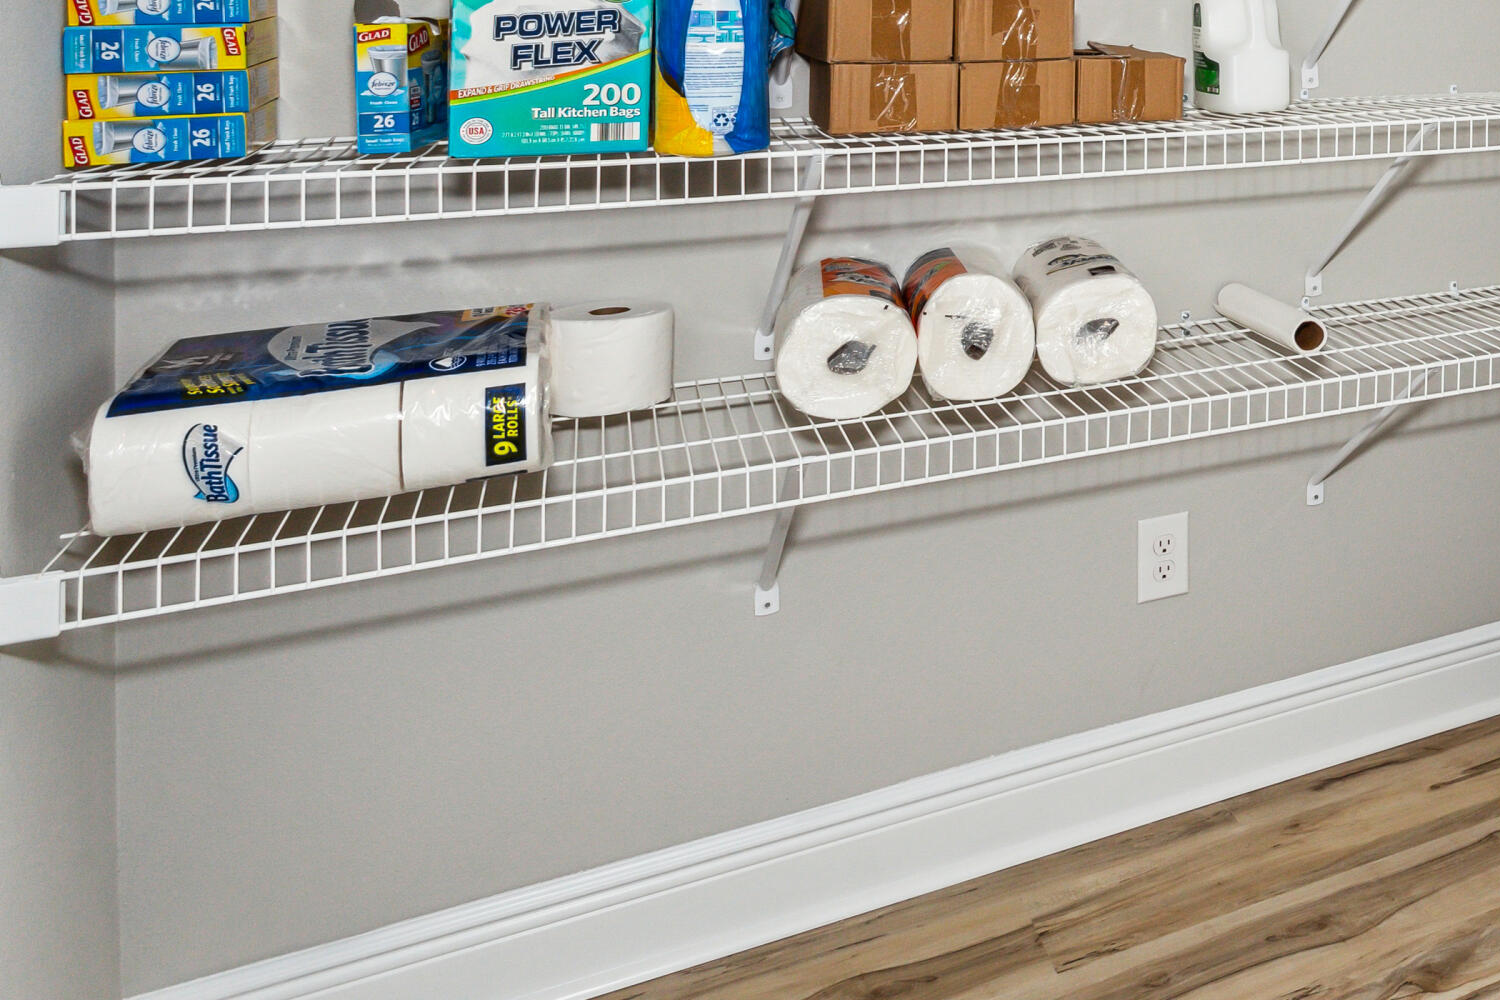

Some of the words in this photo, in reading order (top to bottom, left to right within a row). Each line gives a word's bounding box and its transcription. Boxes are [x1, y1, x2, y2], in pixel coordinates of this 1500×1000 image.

[493, 8, 621, 40] POWER
[224, 28, 238, 55] GLAD
[358, 28, 390, 42] GLAD
[408, 32, 428, 52] GLAD
[100, 41, 119, 60] 26
[510, 38, 604, 70] FLEX
[196, 83, 214, 102] 26
[457, 88, 487, 99] EXPAND
[582, 82, 642, 106] 200
[76, 91, 93, 118] GLAD
[532, 107, 556, 119] Tall
[558, 106, 608, 118] Kitchen
[610, 106, 641, 119] Bags
[373, 114, 395, 128] 26
[192, 128, 210, 147] 26
[468, 127, 484, 136] USA
[72, 137, 88, 164] GLAD
[492, 396, 506, 439] LARGE
[493, 440, 518, 456] 9
[202, 424, 229, 503] BathTissue
